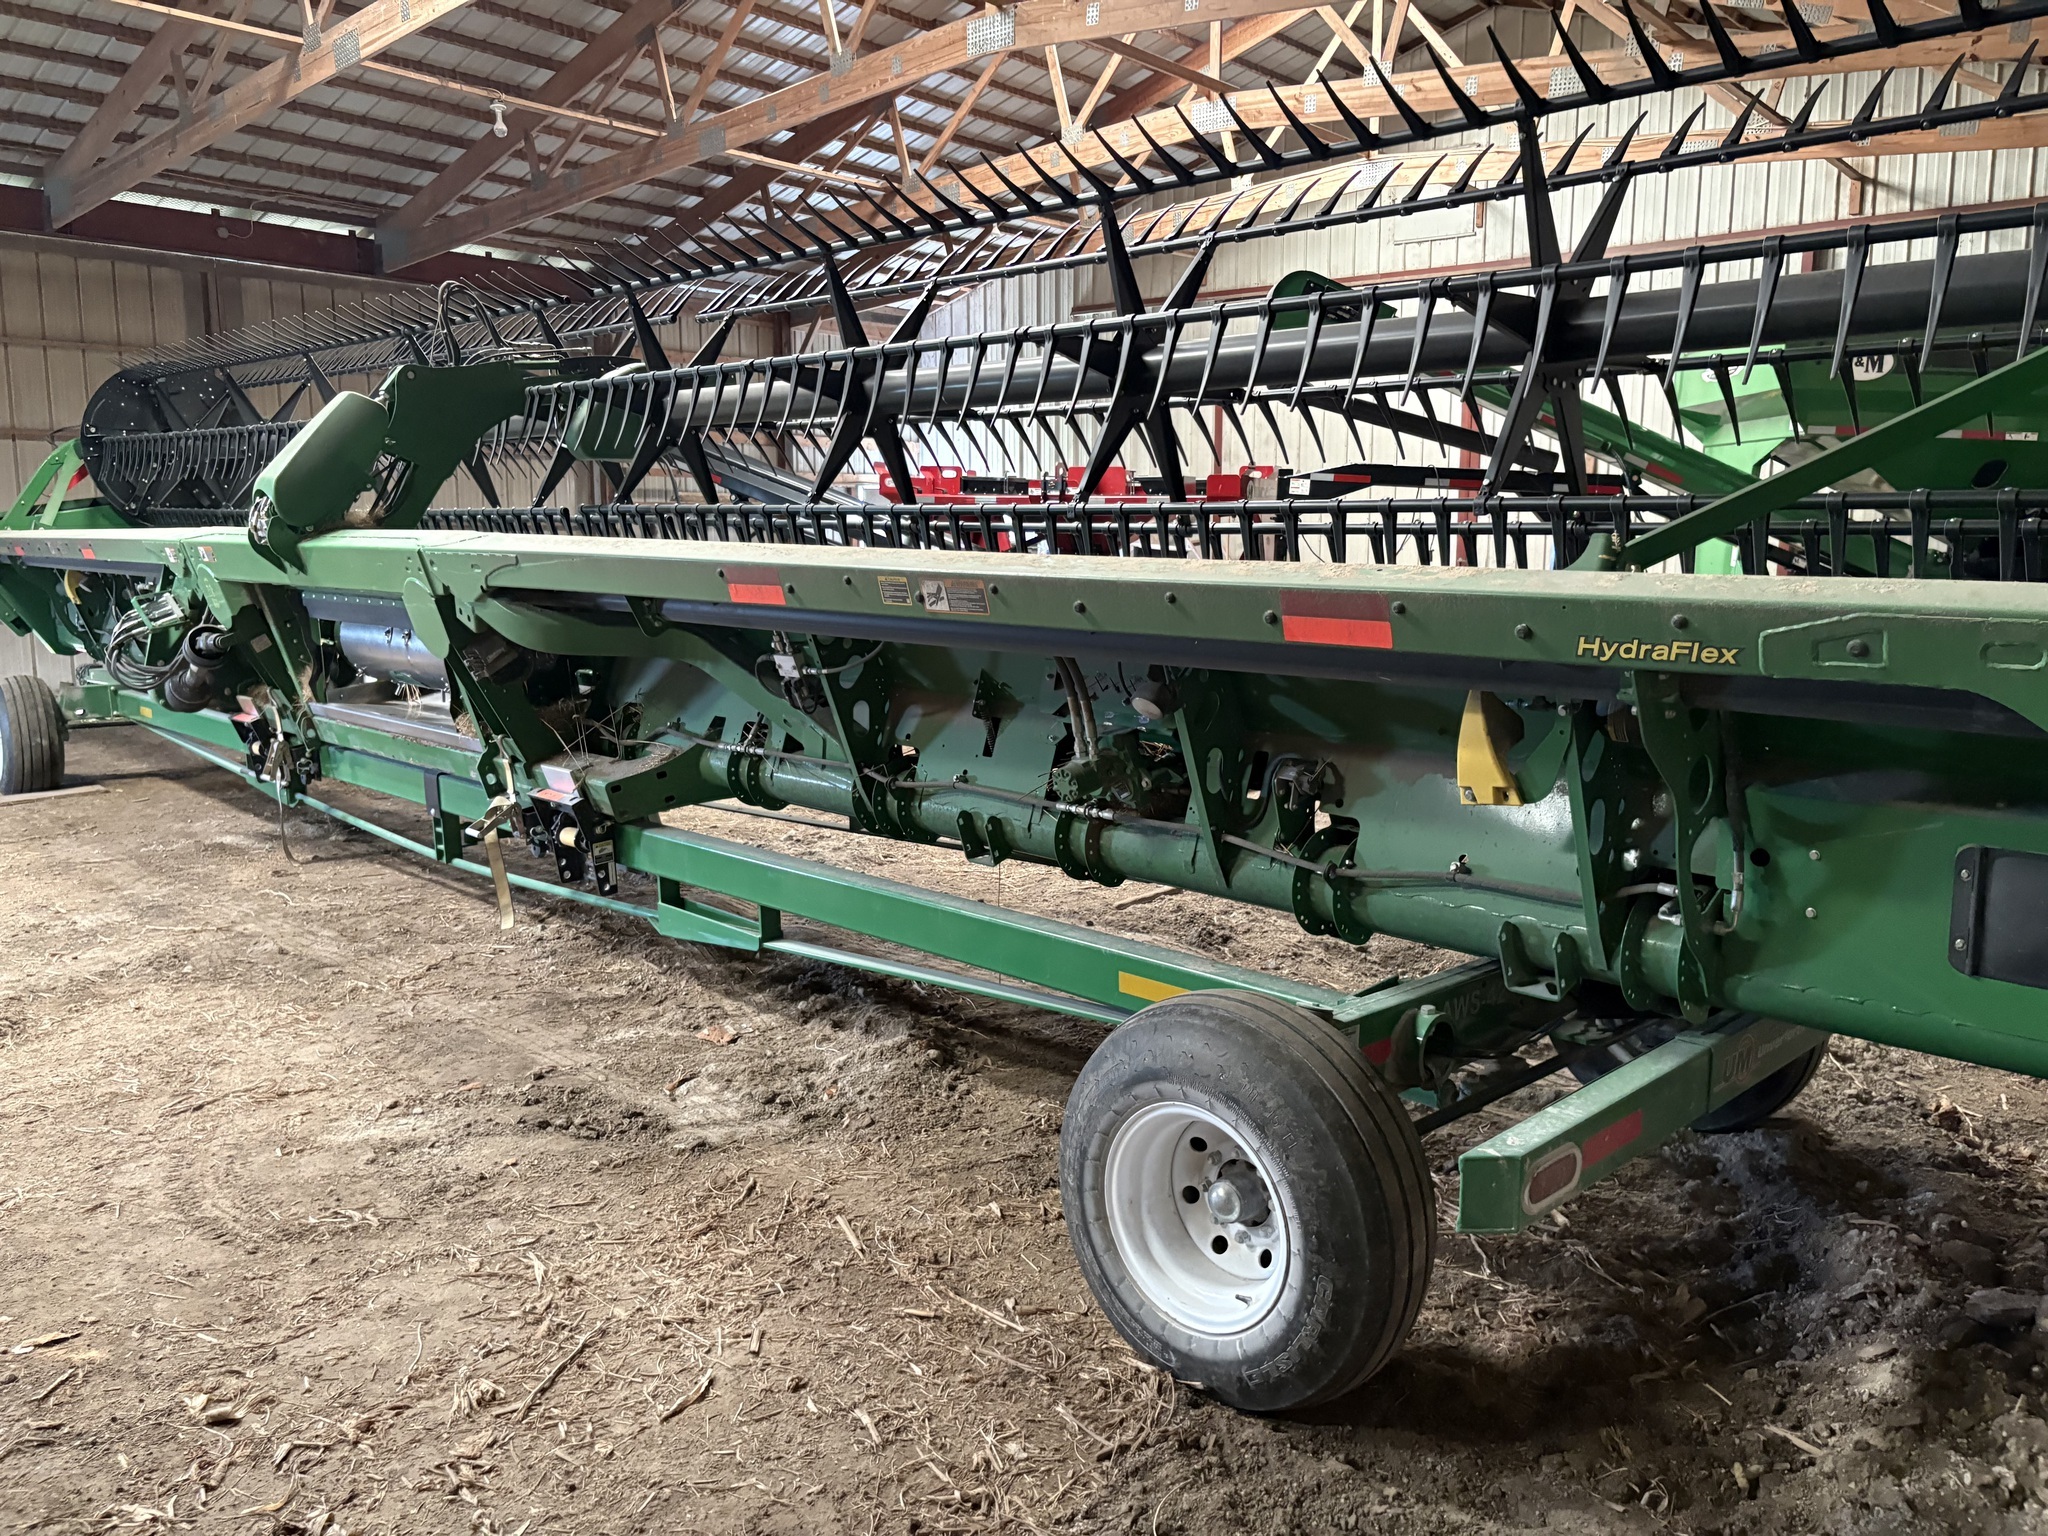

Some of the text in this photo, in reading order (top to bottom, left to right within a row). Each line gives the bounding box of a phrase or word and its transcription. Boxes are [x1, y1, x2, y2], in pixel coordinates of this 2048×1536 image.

[1853, 354, 1885, 374] &M
[1576, 635, 1741, 666] HydraFlex
[1242, 1274, 1334, 1388] CARLISLE
